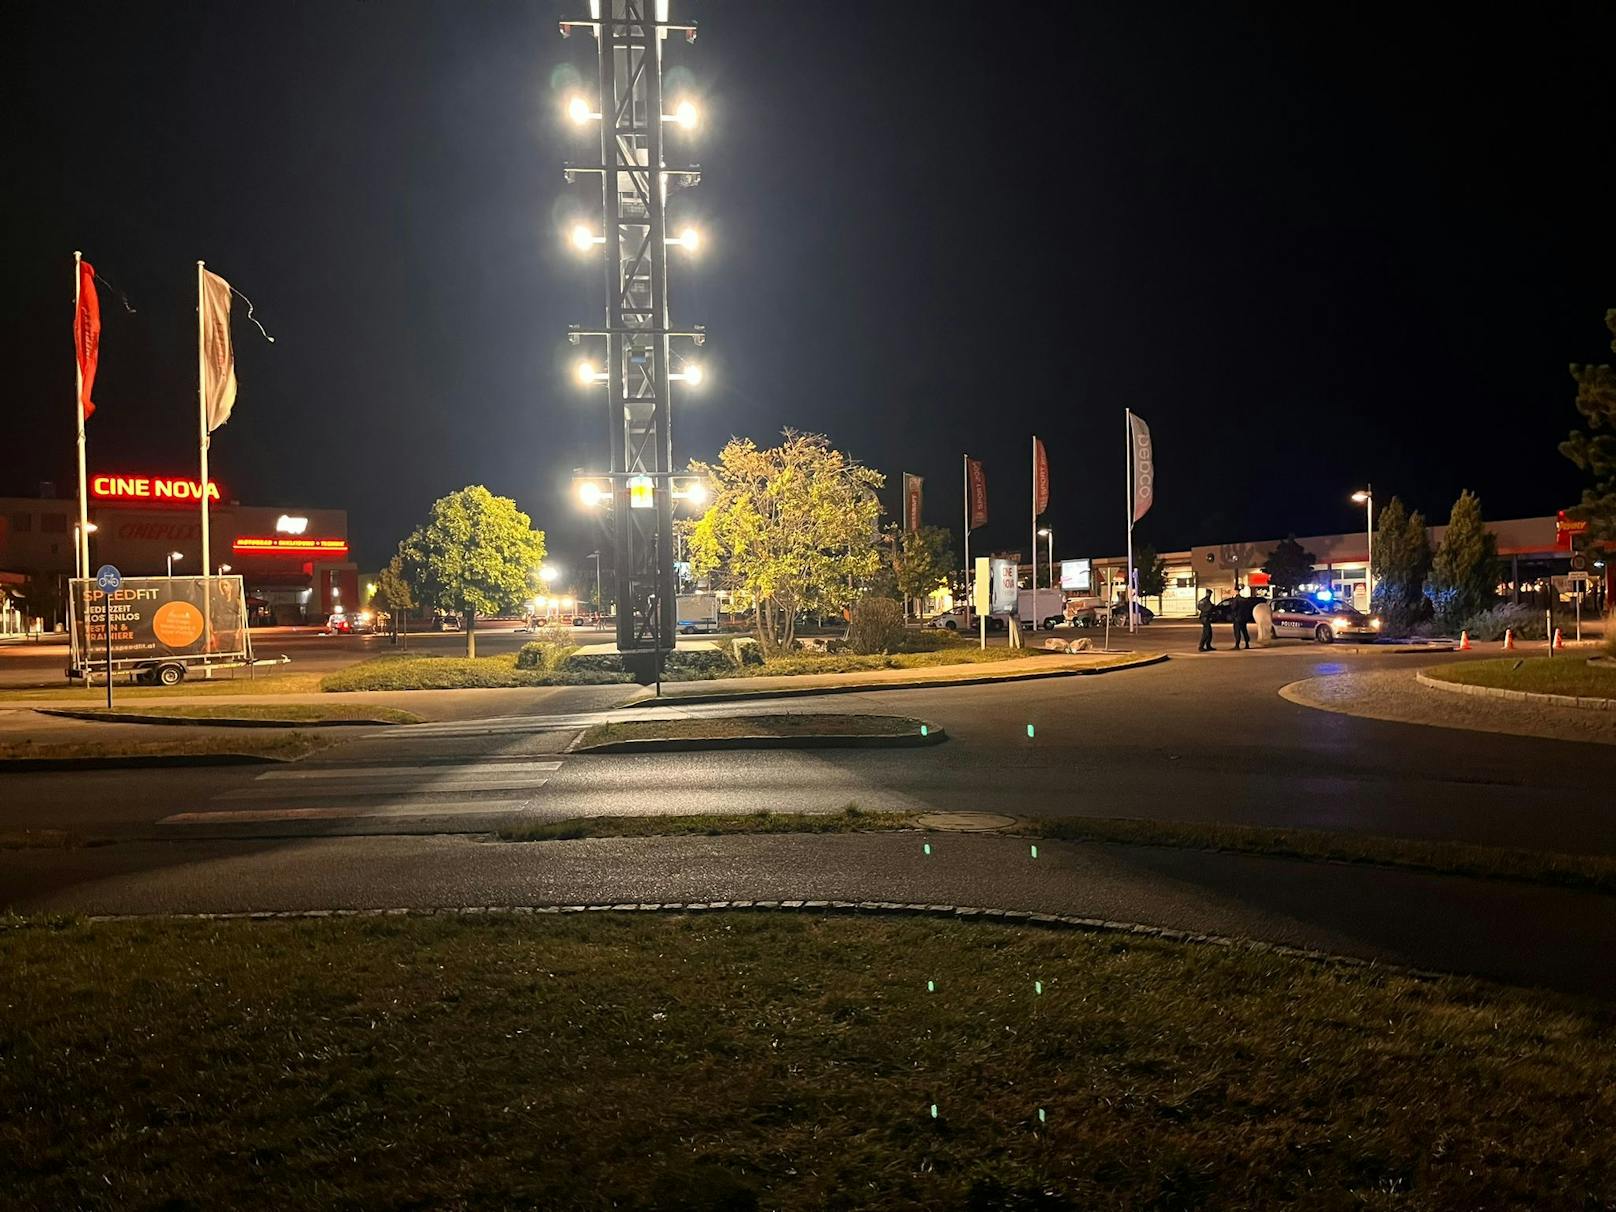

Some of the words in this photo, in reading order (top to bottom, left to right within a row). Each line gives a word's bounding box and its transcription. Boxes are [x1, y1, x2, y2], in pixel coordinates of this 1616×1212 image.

[94, 476, 150, 497] CINE
[155, 480, 220, 500] NOVA
[84, 613, 140, 622] KOSENLOS
[85, 624, 118, 633] TESTN
